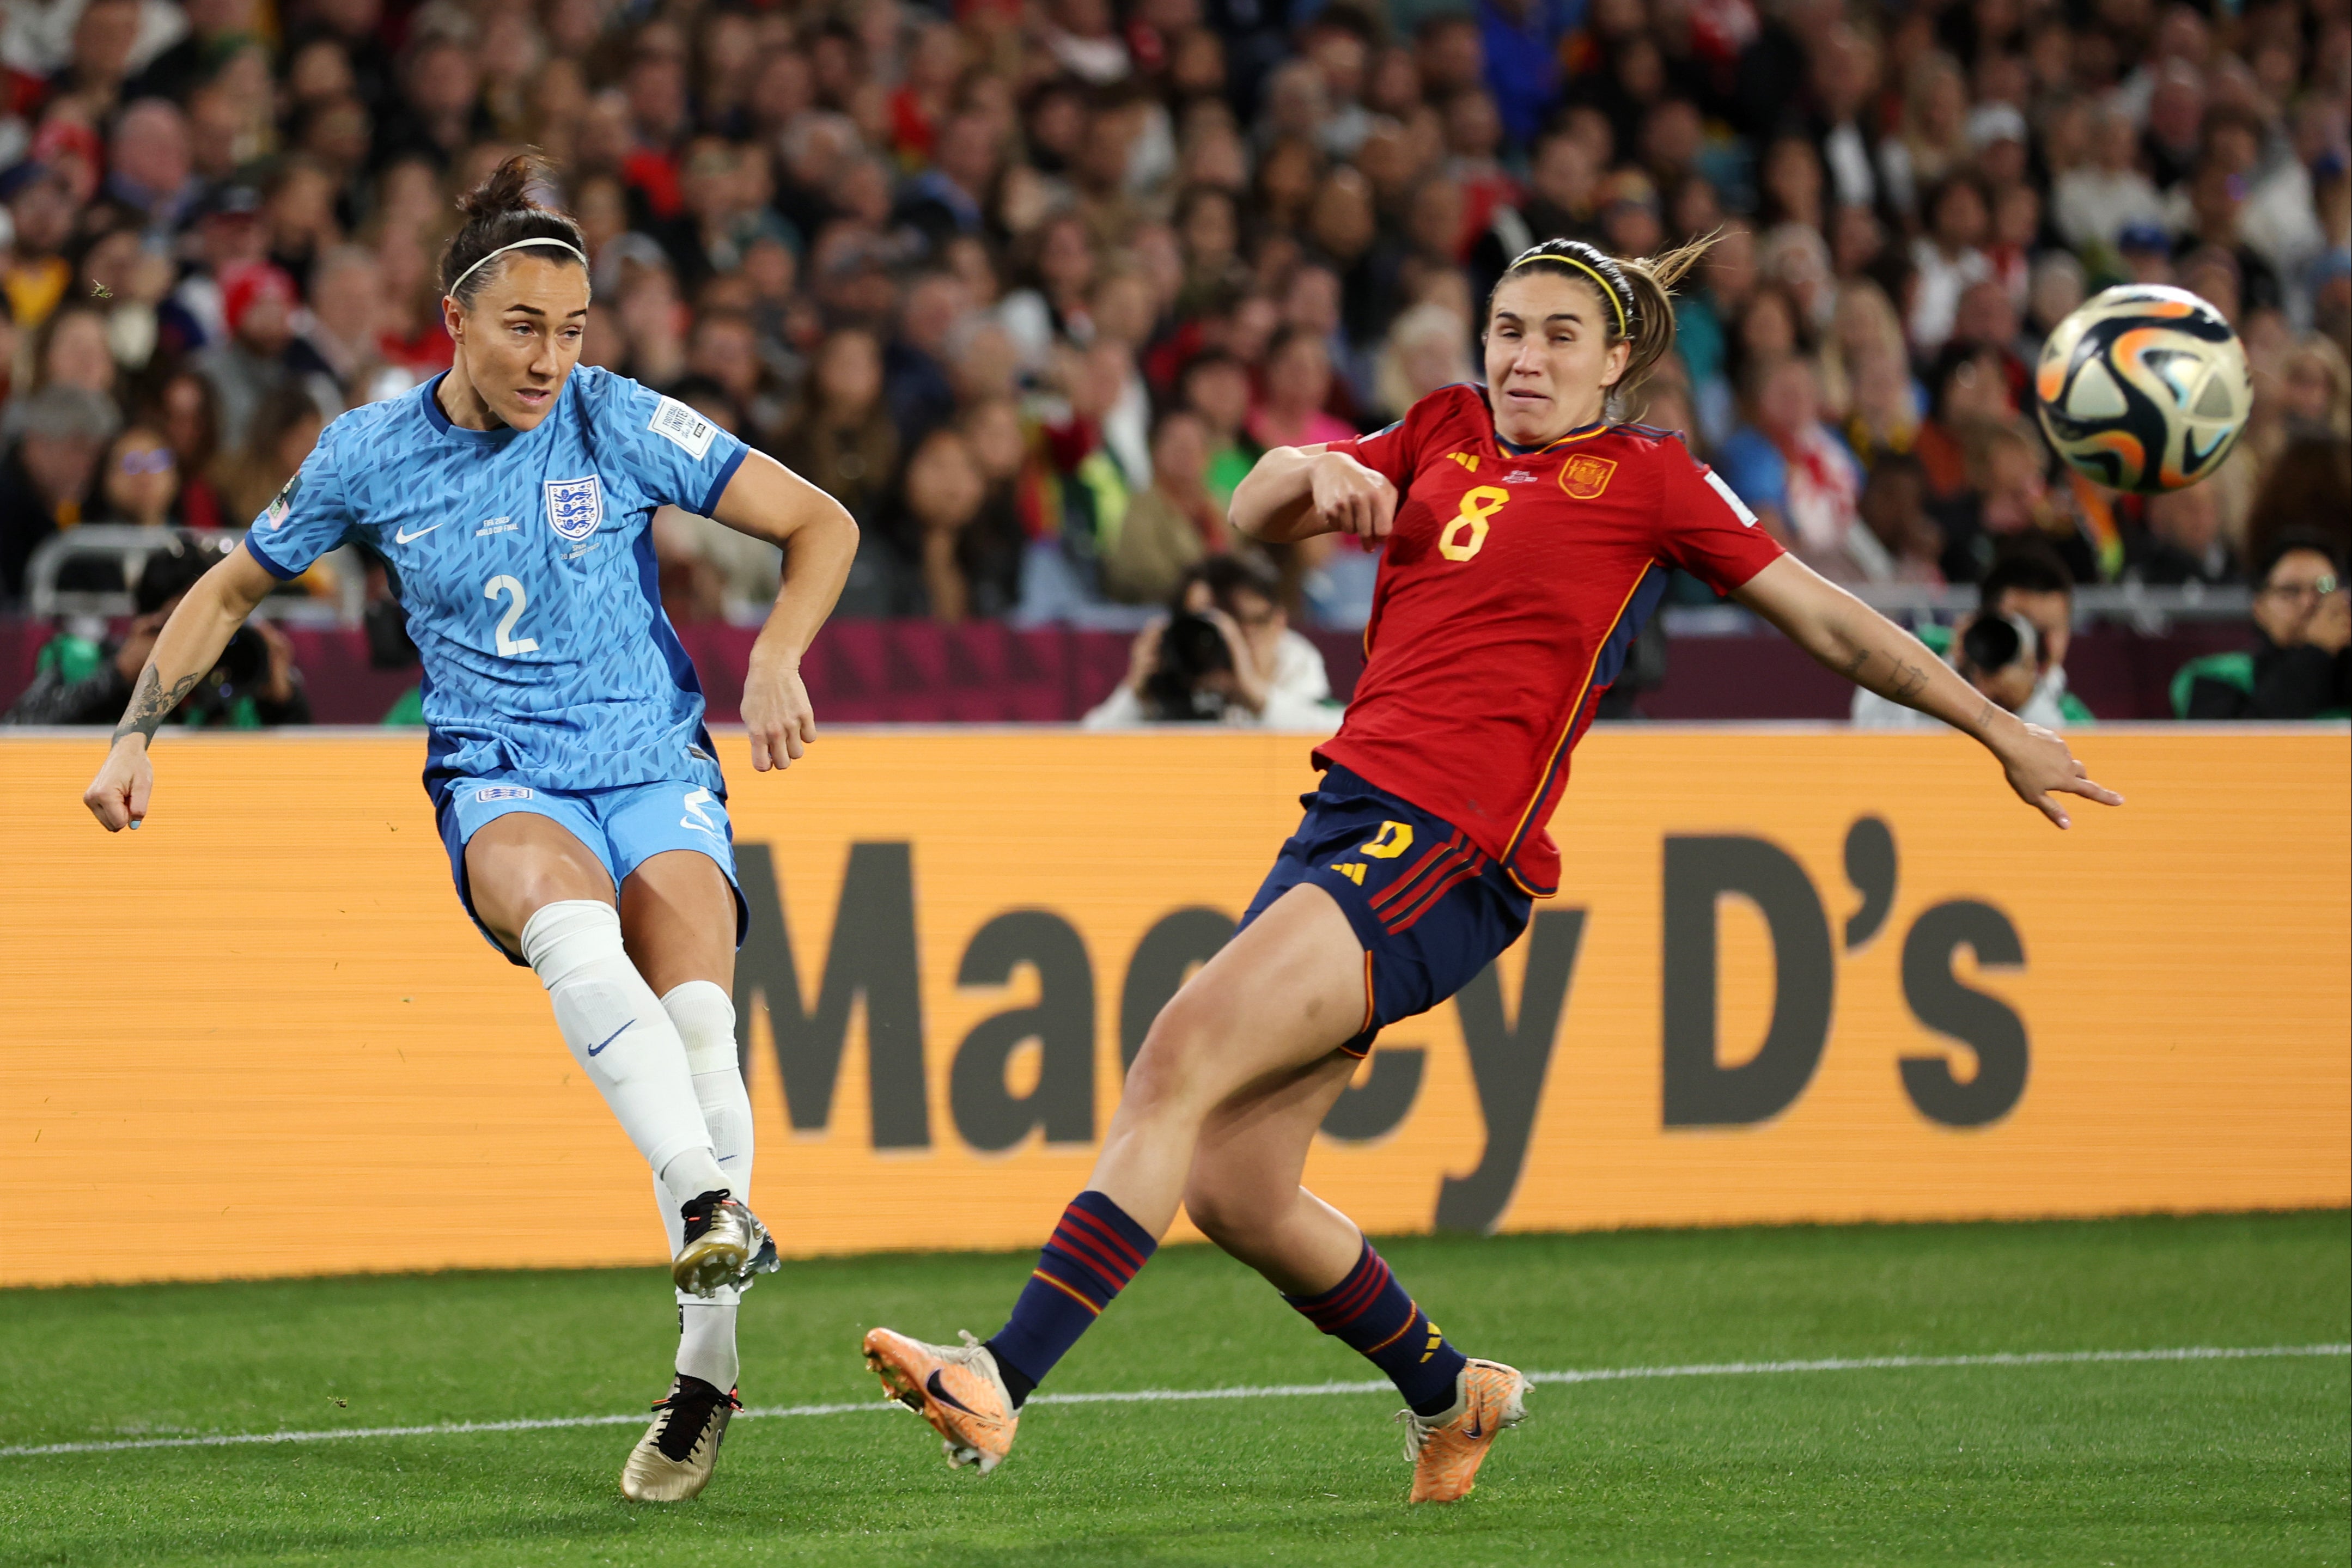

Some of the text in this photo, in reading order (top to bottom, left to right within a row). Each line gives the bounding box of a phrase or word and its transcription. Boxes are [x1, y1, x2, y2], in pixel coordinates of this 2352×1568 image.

[1439, 485, 1510, 562] 8
[484, 575, 540, 657] 2
[1664, 815, 2029, 1129] D's
